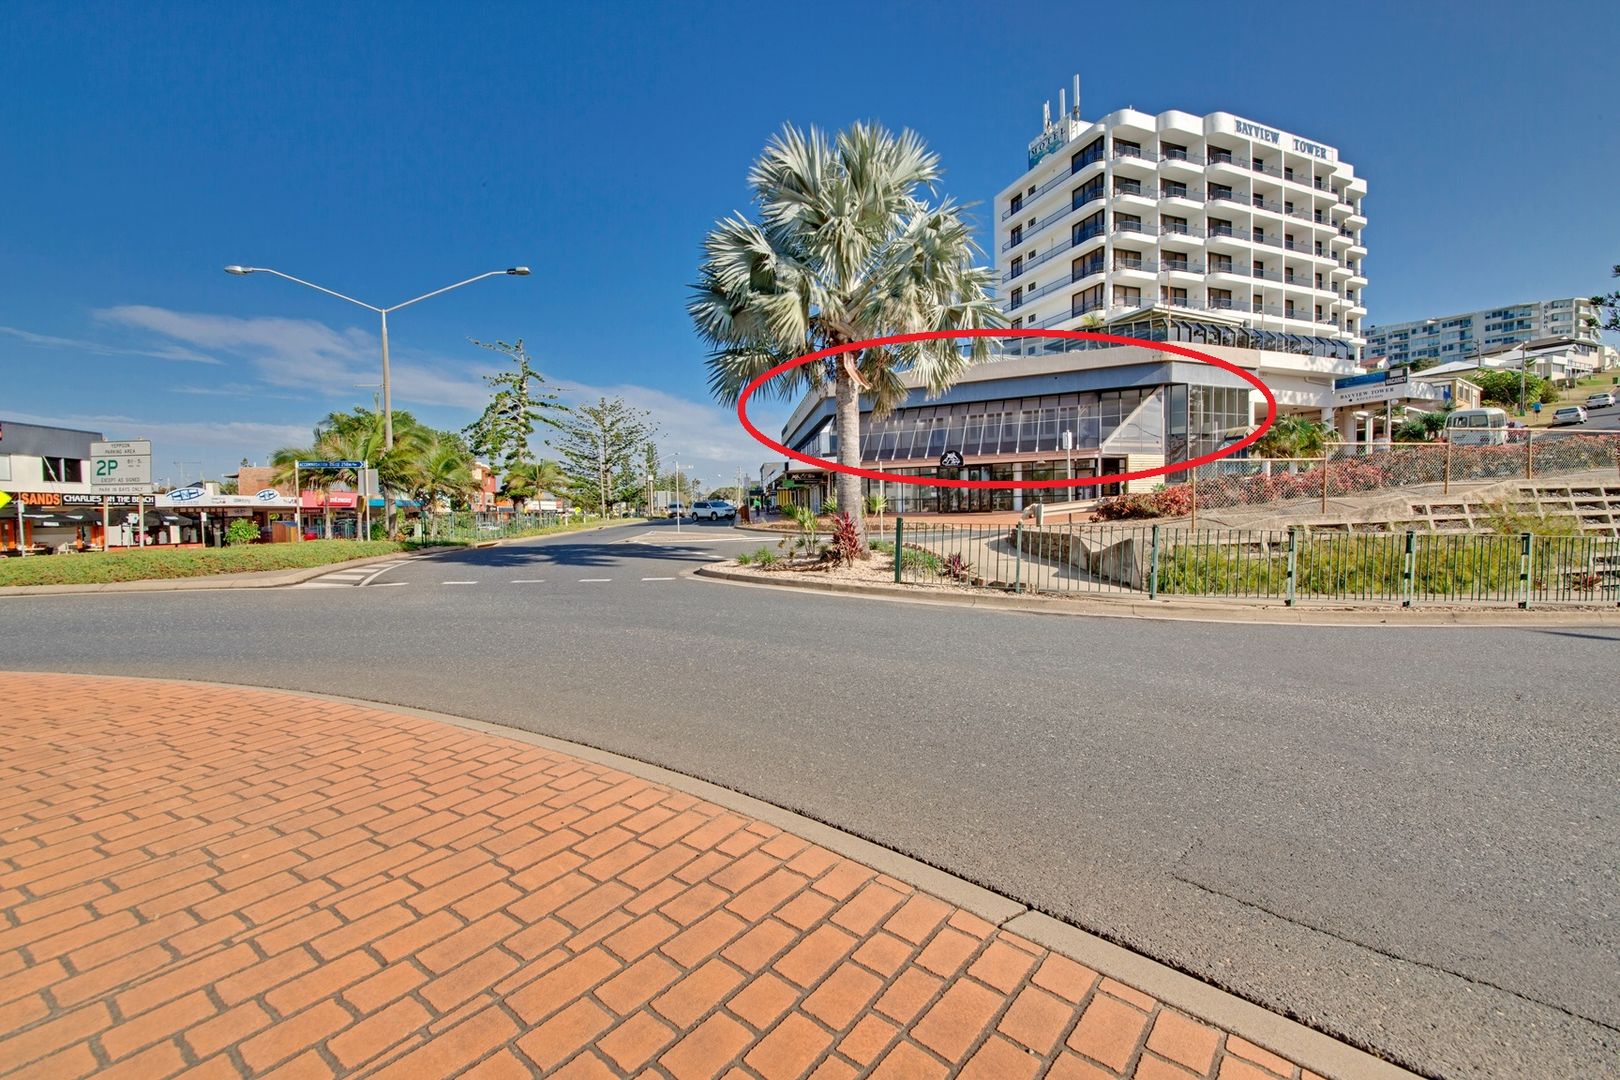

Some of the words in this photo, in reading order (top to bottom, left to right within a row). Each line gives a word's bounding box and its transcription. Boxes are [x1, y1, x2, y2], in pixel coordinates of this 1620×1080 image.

[1236, 120, 1280, 145] BAYVIEW
[1294, 139, 1327, 159] TOWER
[1386, 377, 1407, 385] VACANCY
[1340, 391, 1368, 399] BAYVIEW
[1370, 387, 1394, 395] TOWER
[96, 459, 119, 476] 2P
[21, 492, 61, 505] SANDS
